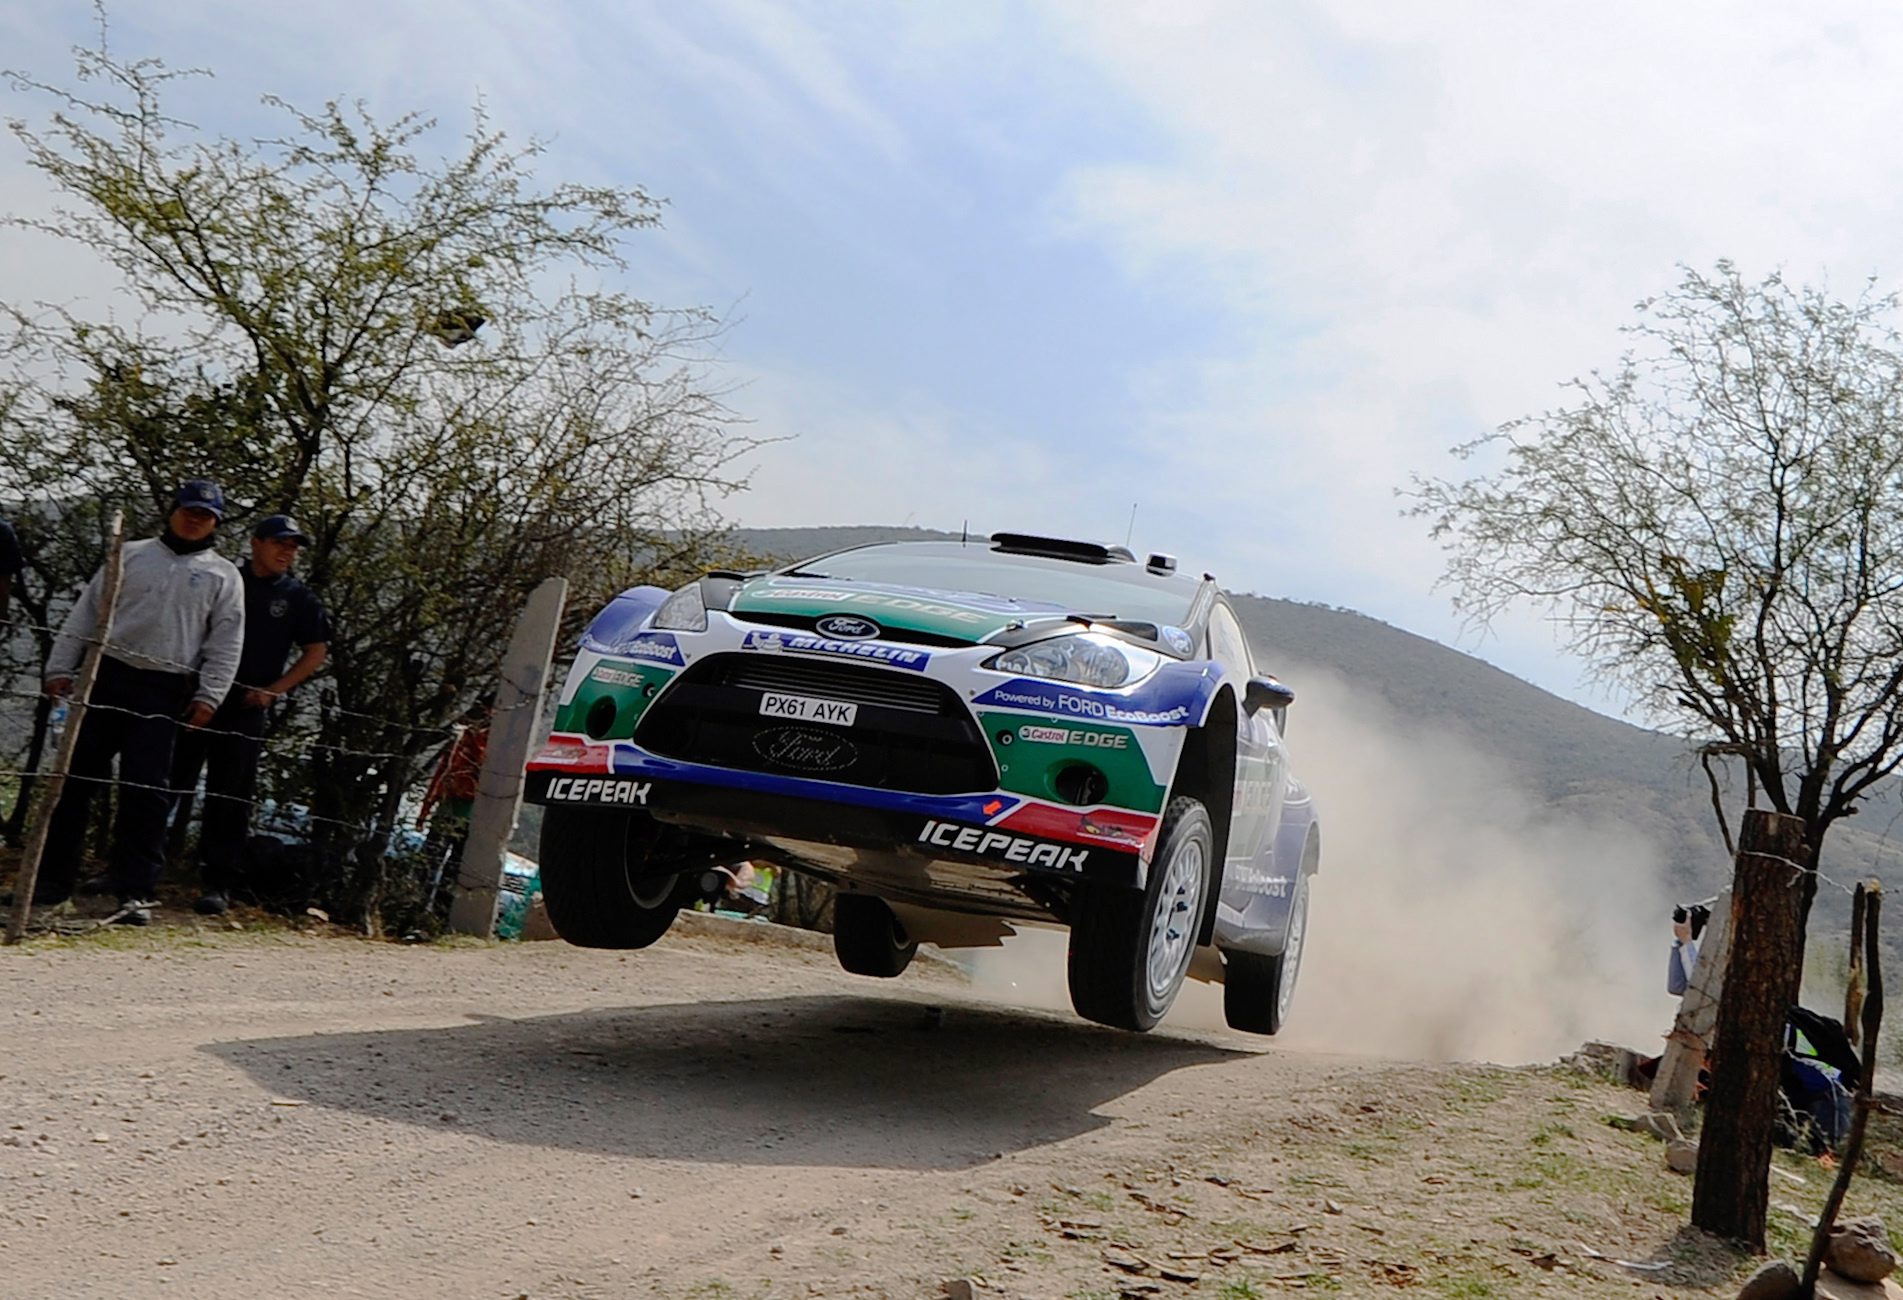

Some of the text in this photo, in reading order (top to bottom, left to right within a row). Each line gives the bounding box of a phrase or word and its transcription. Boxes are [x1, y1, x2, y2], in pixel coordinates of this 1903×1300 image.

[853, 595, 988, 623] EDGE
[828, 617, 866, 634] Ford
[789, 637, 920, 663] MICHELIN
[765, 696, 851, 722] PX61 AYK
[994, 690, 1190, 722] Powered by FORD EcoBoost
[769, 730, 841, 767] Ford
[1031, 729, 1130, 749] Castrol EDGE
[545, 777, 652, 805] ICEPEAK
[917, 820, 1090, 873] ICEPEAK
